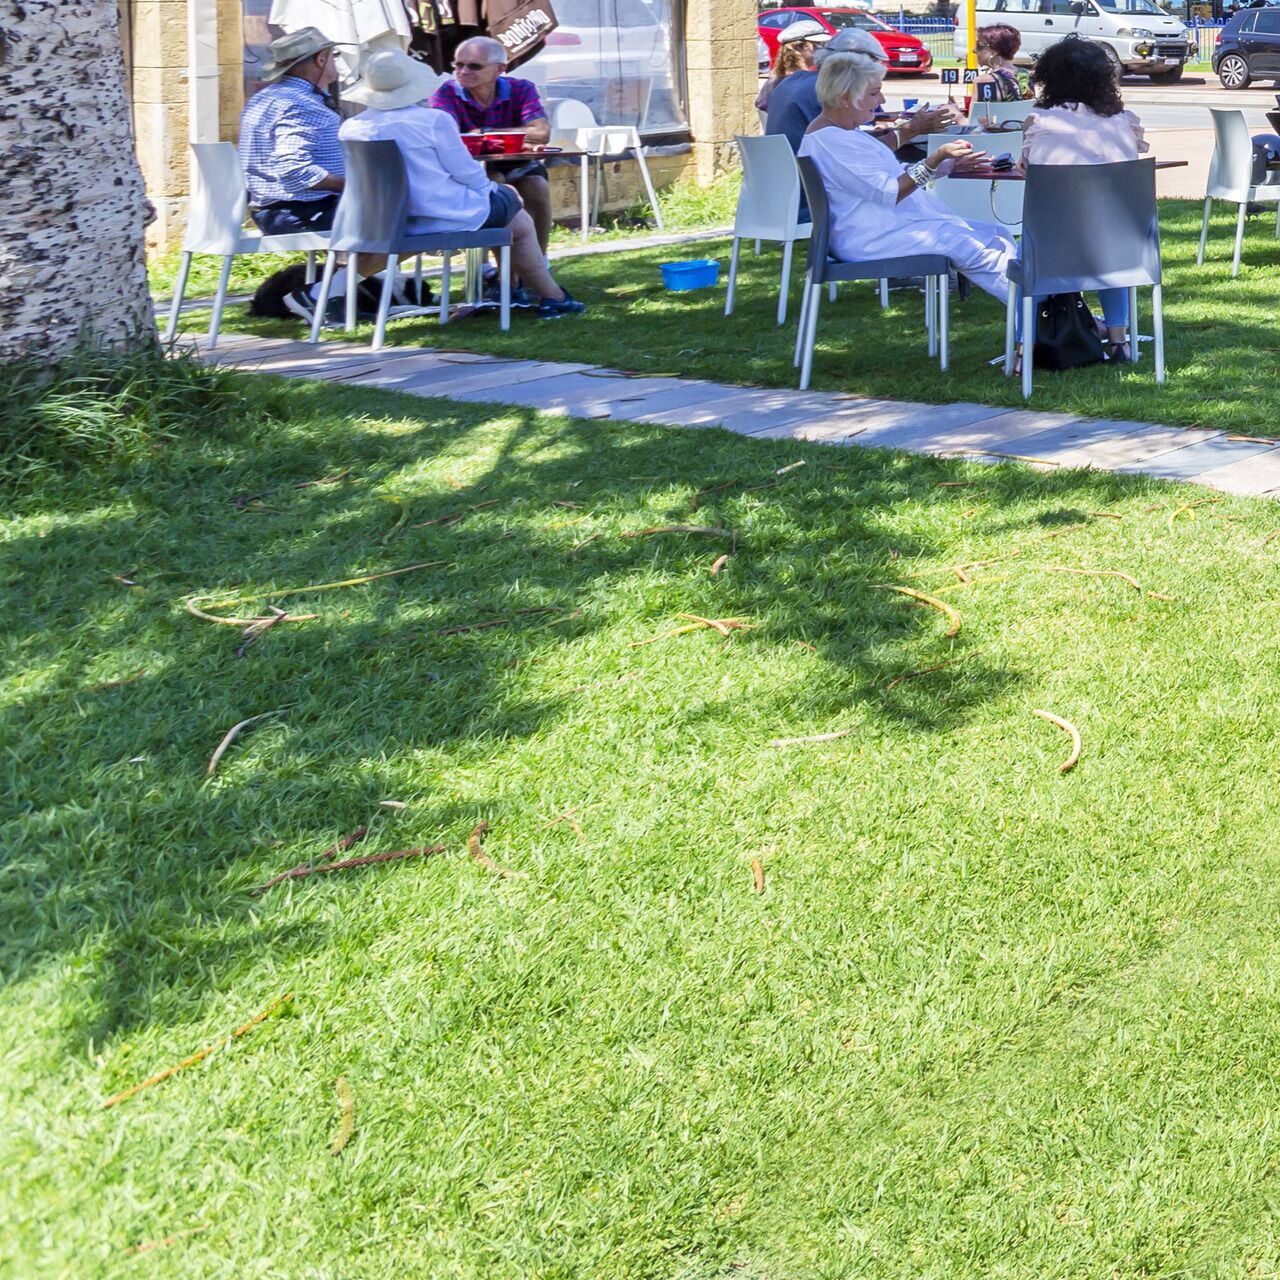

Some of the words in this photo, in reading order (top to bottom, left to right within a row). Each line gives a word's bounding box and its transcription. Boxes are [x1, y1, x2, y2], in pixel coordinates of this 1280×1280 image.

[944, 70, 956, 82] 19
[965, 70, 977, 81] 20
[983, 84, 992, 98] 6
